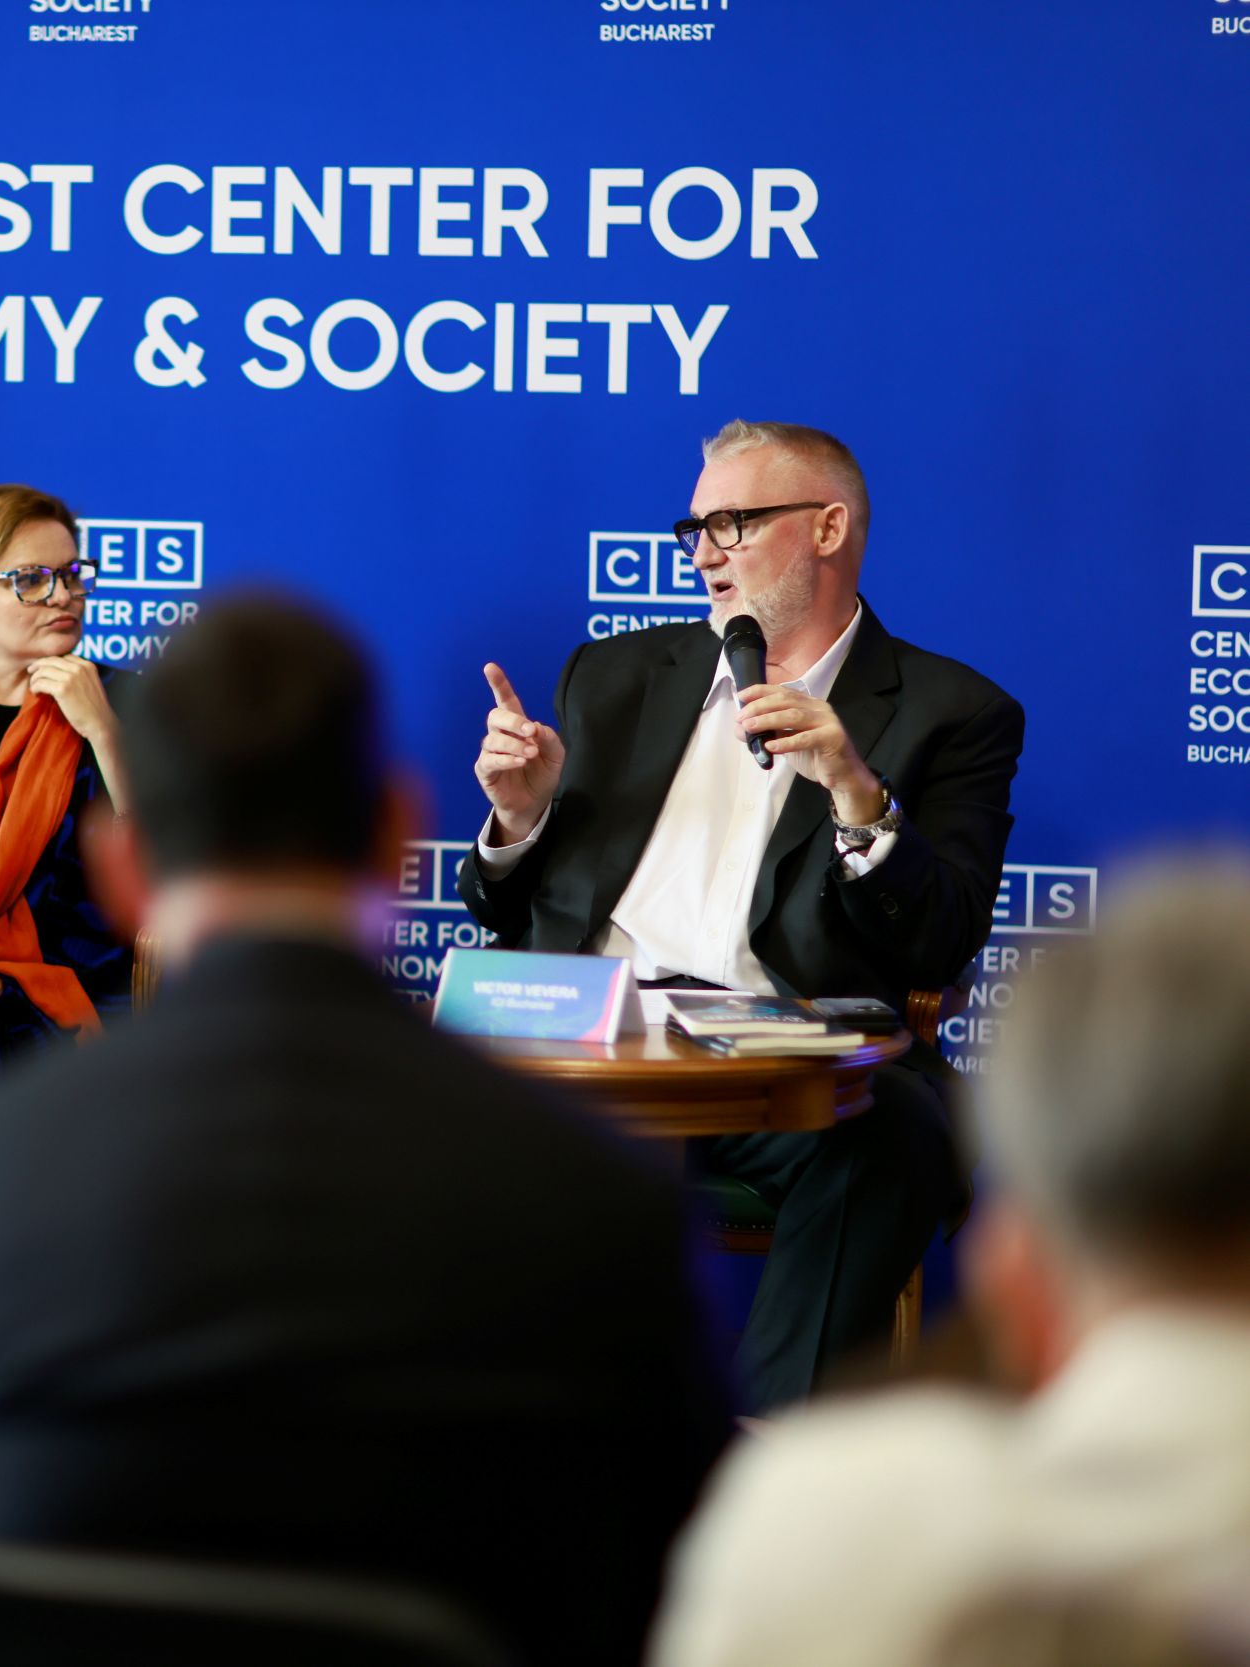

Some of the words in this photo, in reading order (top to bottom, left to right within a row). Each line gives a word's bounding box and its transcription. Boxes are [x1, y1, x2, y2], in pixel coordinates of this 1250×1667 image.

[30, 26, 137, 41] BUCHAREST
[600, 24, 715, 41] BUCHAREST
[124, 164, 548, 257] CENTER
[588, 167, 818, 260] FOR
[135, 297, 206, 387] &
[241, 298, 729, 394] SOCIETY
[101, 535, 183, 574] ES
[606, 548, 696, 588] CE
[85, 600, 133, 626] TER
[140, 602, 198, 626] FOR
[72, 634, 170, 661] NOMY
[992, 880, 1075, 918] ES
